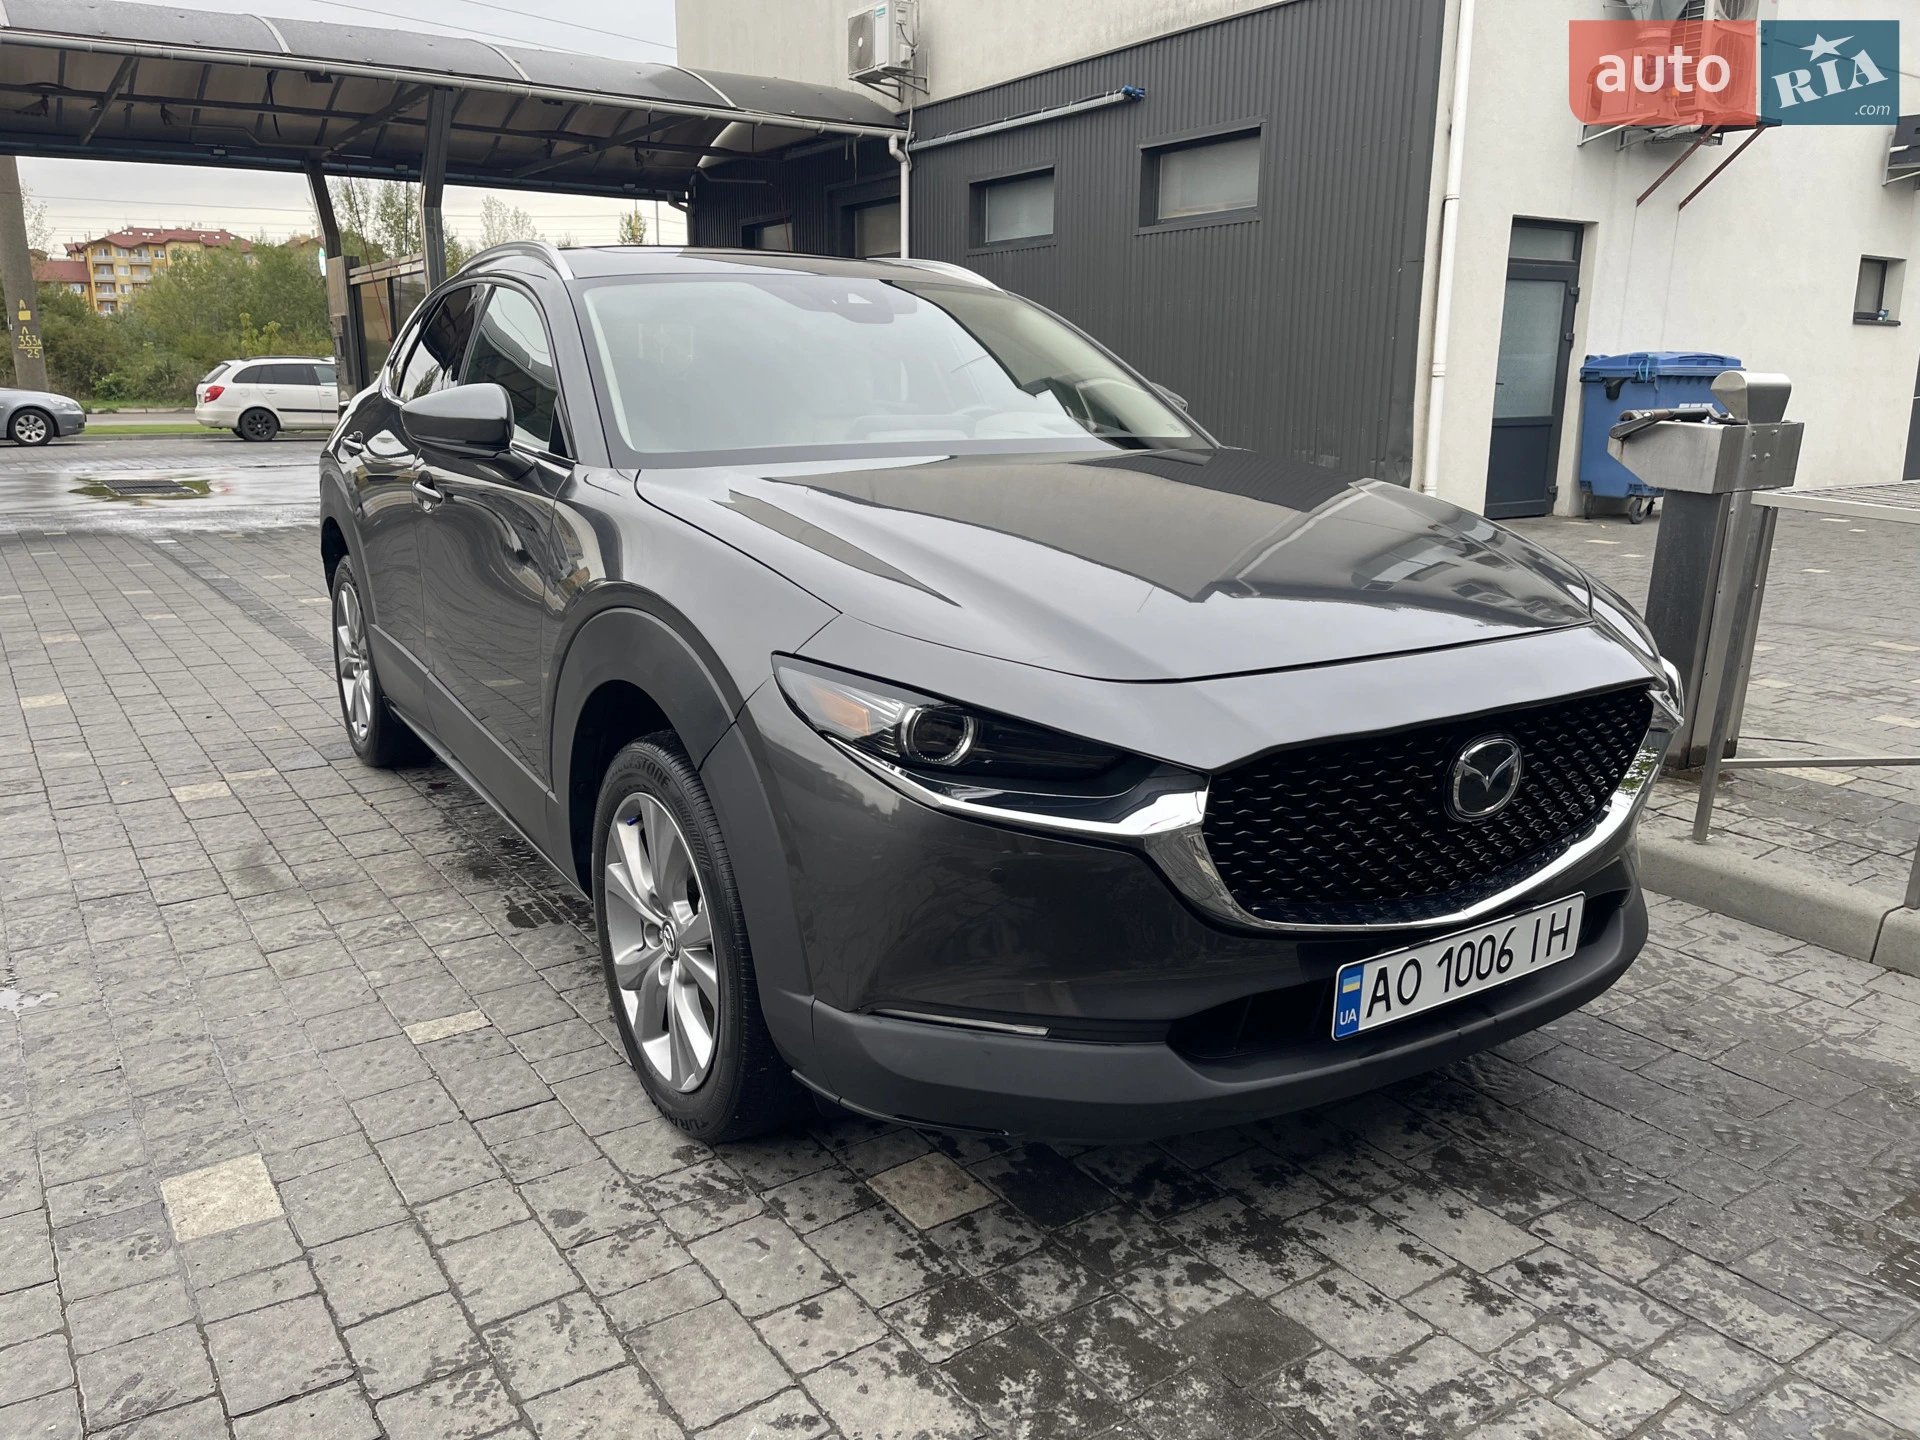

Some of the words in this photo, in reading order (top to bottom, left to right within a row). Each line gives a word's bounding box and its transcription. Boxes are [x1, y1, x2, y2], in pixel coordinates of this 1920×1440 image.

[28, 349, 39, 358] 25
[1366, 958, 1422, 1018] AO
[1436, 926, 1517, 993] 1006
[1530, 907, 1573, 963] IH
[1339, 1008, 1358, 1026] UA
